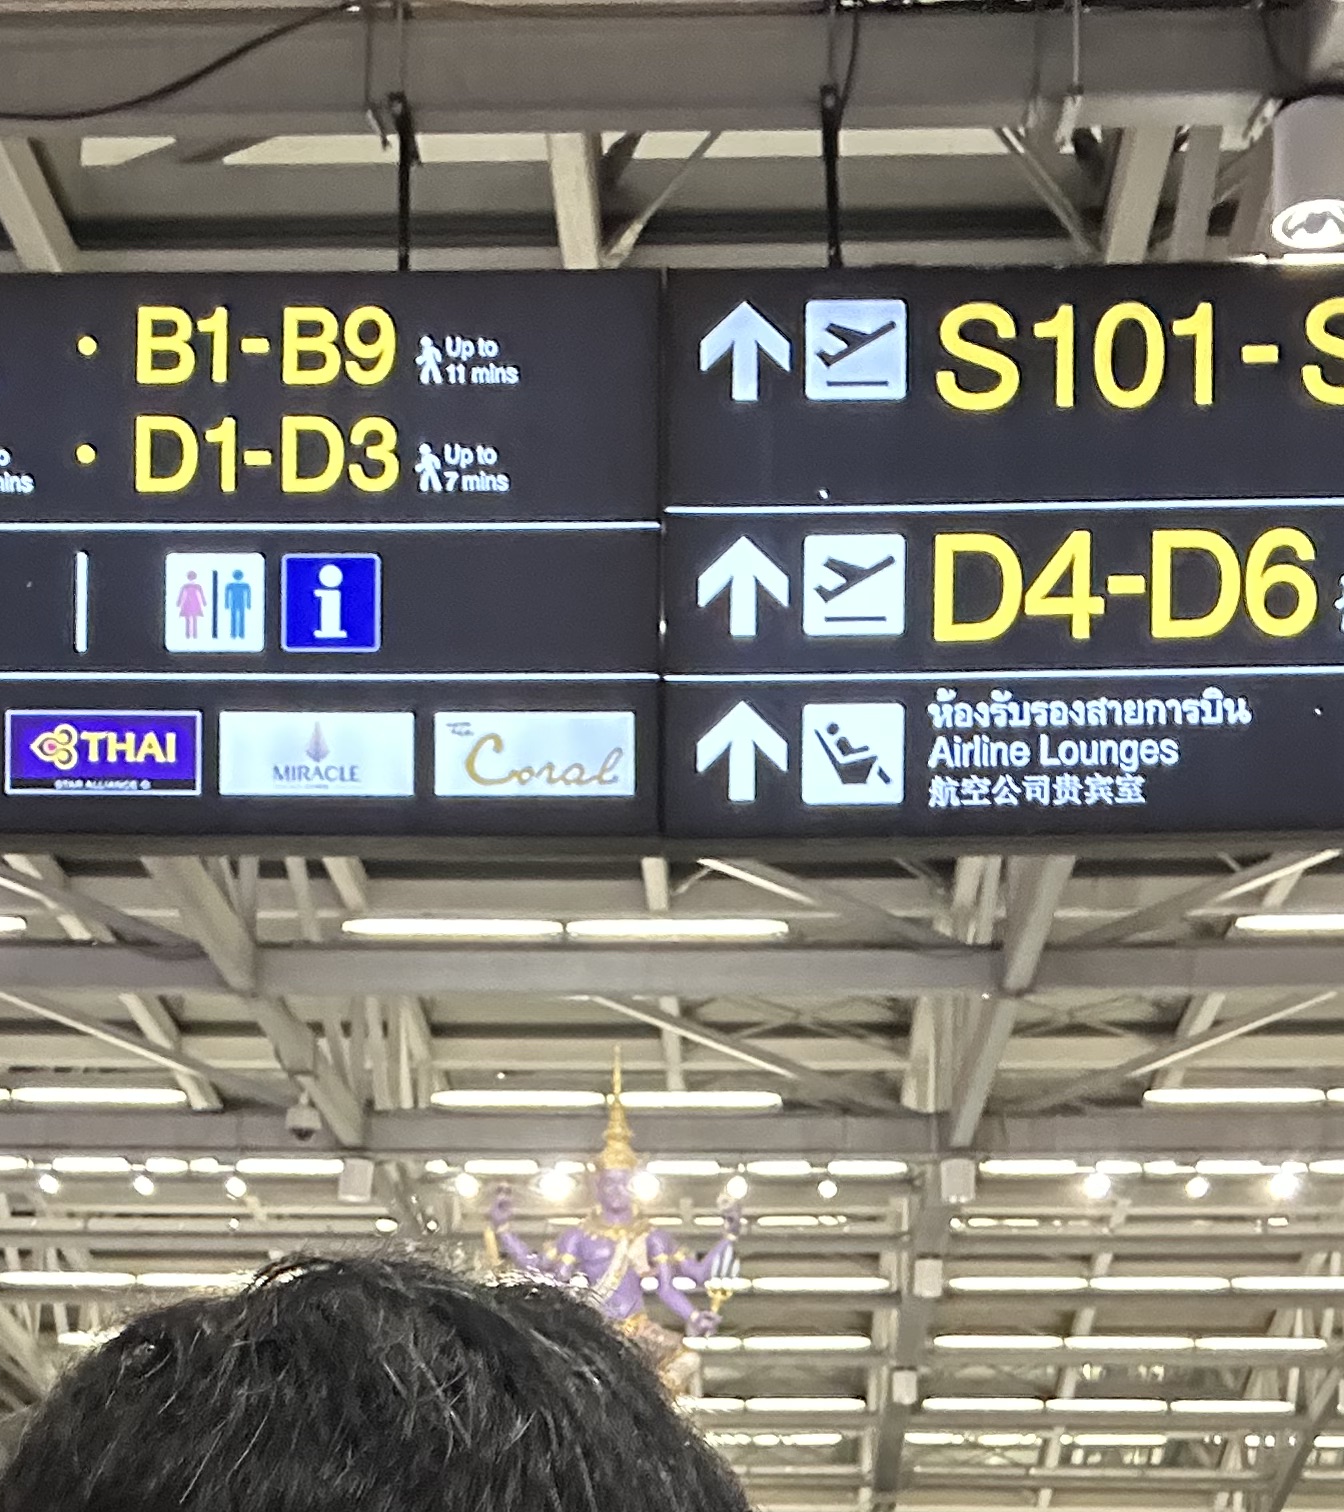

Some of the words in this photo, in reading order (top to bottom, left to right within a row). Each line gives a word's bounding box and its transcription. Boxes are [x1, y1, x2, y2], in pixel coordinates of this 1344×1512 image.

[137, 306, 395, 385] B1-B9
[446, 336, 473, 361] Up
[472, 338, 499, 358] to
[446, 363, 466, 384] 11
[471, 363, 519, 384] mins
[136, 416, 399, 492] D1-D3
[444, 444, 472, 469] Up
[472, 445, 497, 465] to
[443, 471, 459, 492] 7
[462, 468, 509, 493] mins
[934, 528, 1317, 642] D4-D6
[928, 687, 1252, 729] ห้องรับรองสายการบิน
[80, 731, 176, 763] THAI
[464, 731, 626, 786] Coral
[928, 734, 1031, 769] Airline
[1039, 734, 1179, 774] Lounges
[271, 764, 360, 783] MIRACLE
[929, 774, 1145, 808] 航空公司贵宾室
